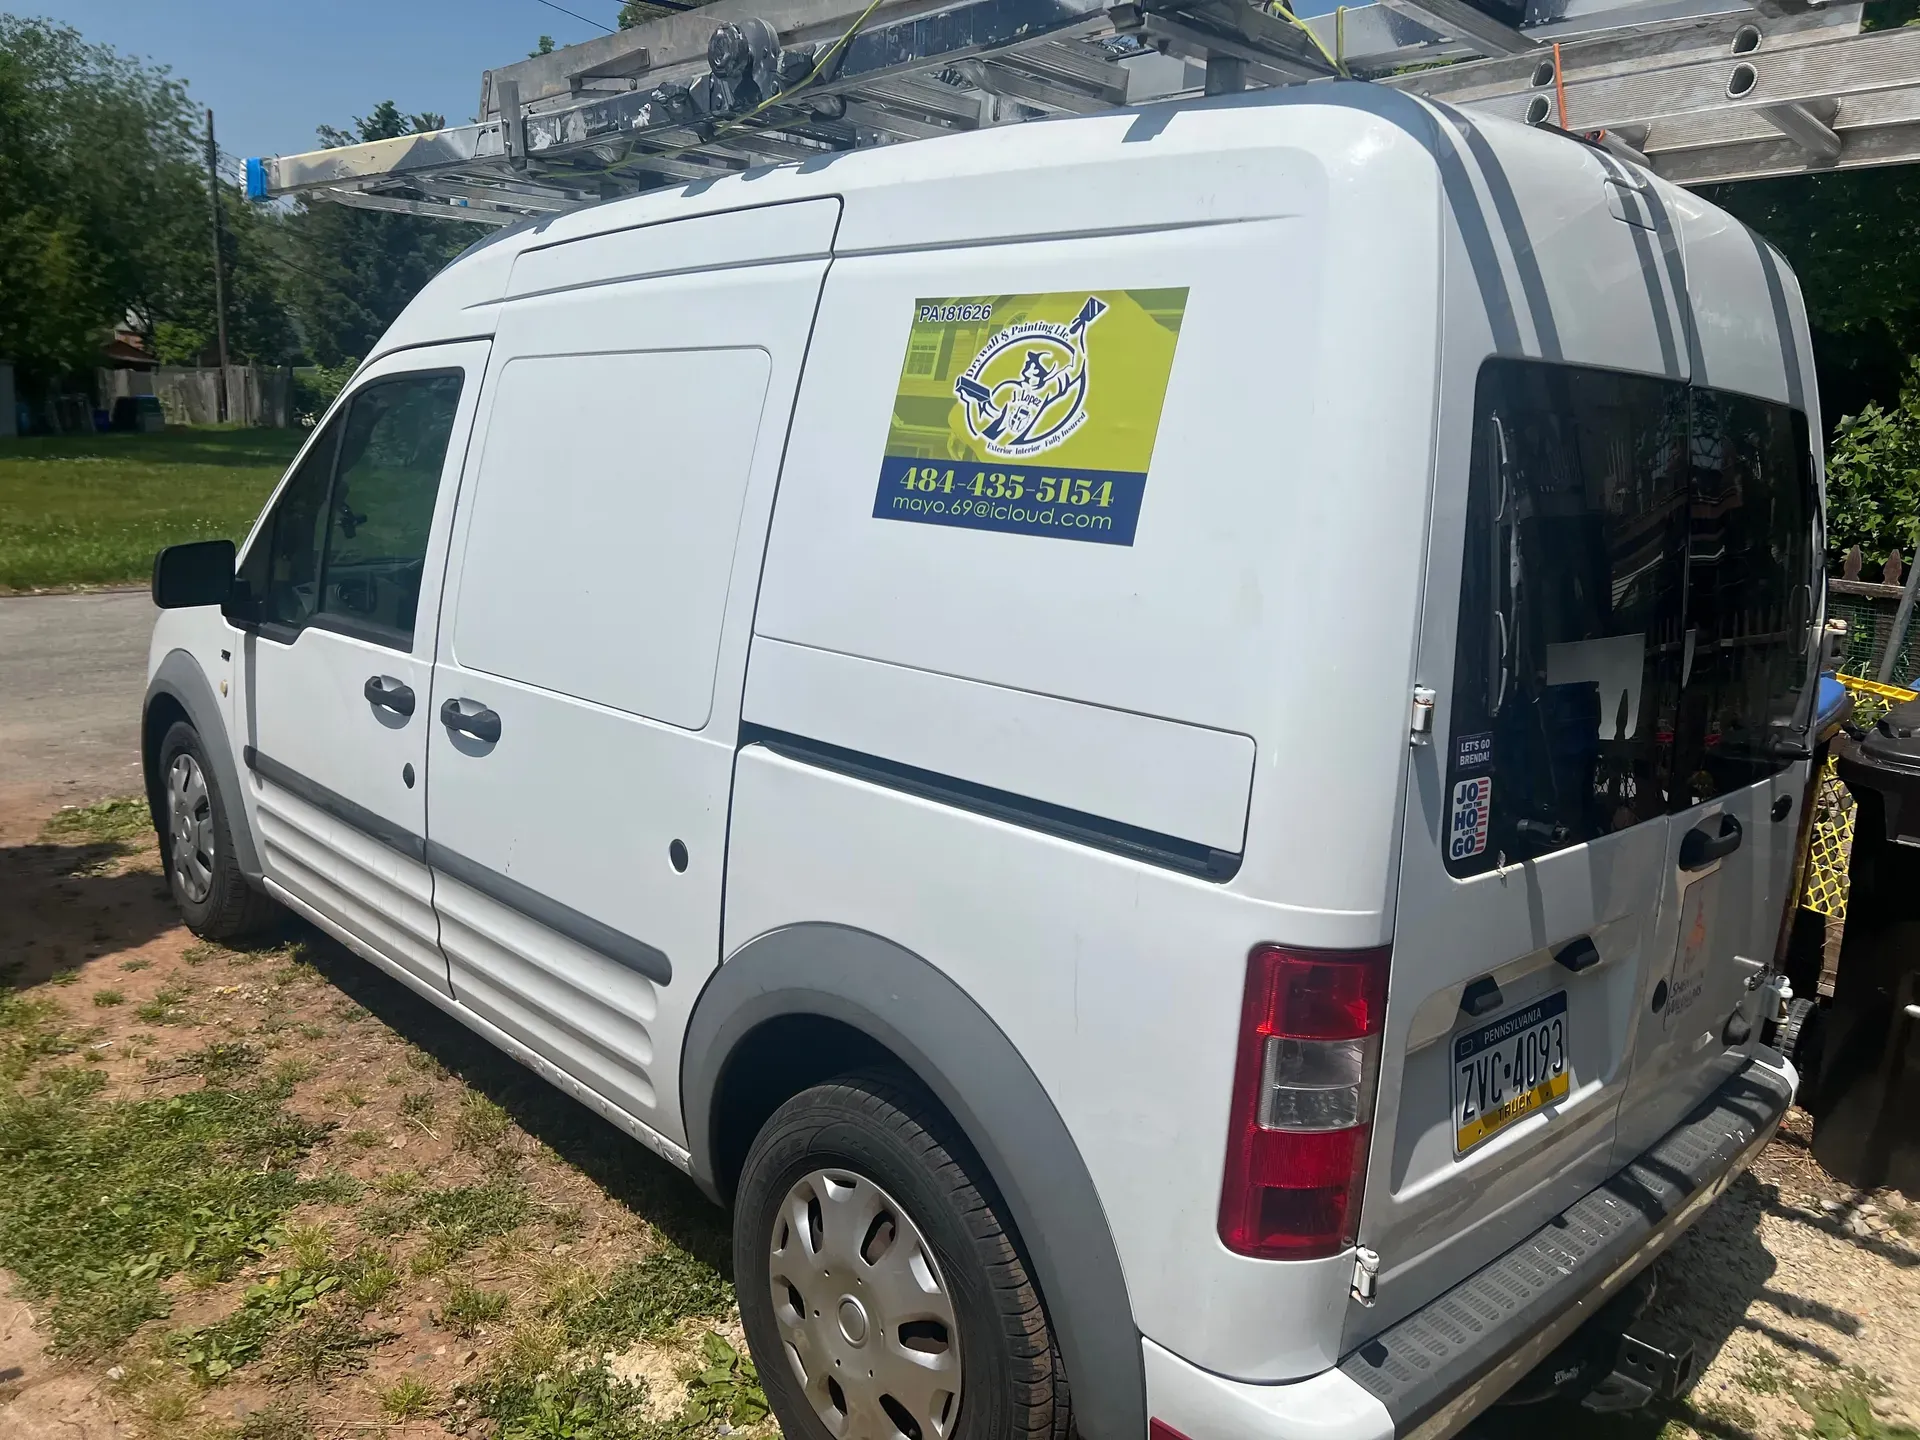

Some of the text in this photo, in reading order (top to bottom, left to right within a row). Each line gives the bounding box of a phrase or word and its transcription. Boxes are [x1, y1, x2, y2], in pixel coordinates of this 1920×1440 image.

[918, 304, 992, 323] PA181626
[966, 336, 999, 377] Drywall
[1011, 321, 1055, 336] Painting
[986, 411, 1086, 455] Exterior Interior Fully Insured
[899, 466, 1115, 508] 484-435-5154
[892, 495, 1112, 530] mayo.69@icloud.com
[1460, 738, 1491, 753] LET'S GO
[1459, 751, 1490, 766] BRENDA!
[1456, 782, 1479, 805] JO
[1454, 808, 1478, 831] HO
[1462, 827, 1478, 836] GOTTA
[1452, 835, 1476, 857] GO
[1484, 1007, 1542, 1045] PENNSYLVANIA
[1498, 1092, 1533, 1122] TRUCK
